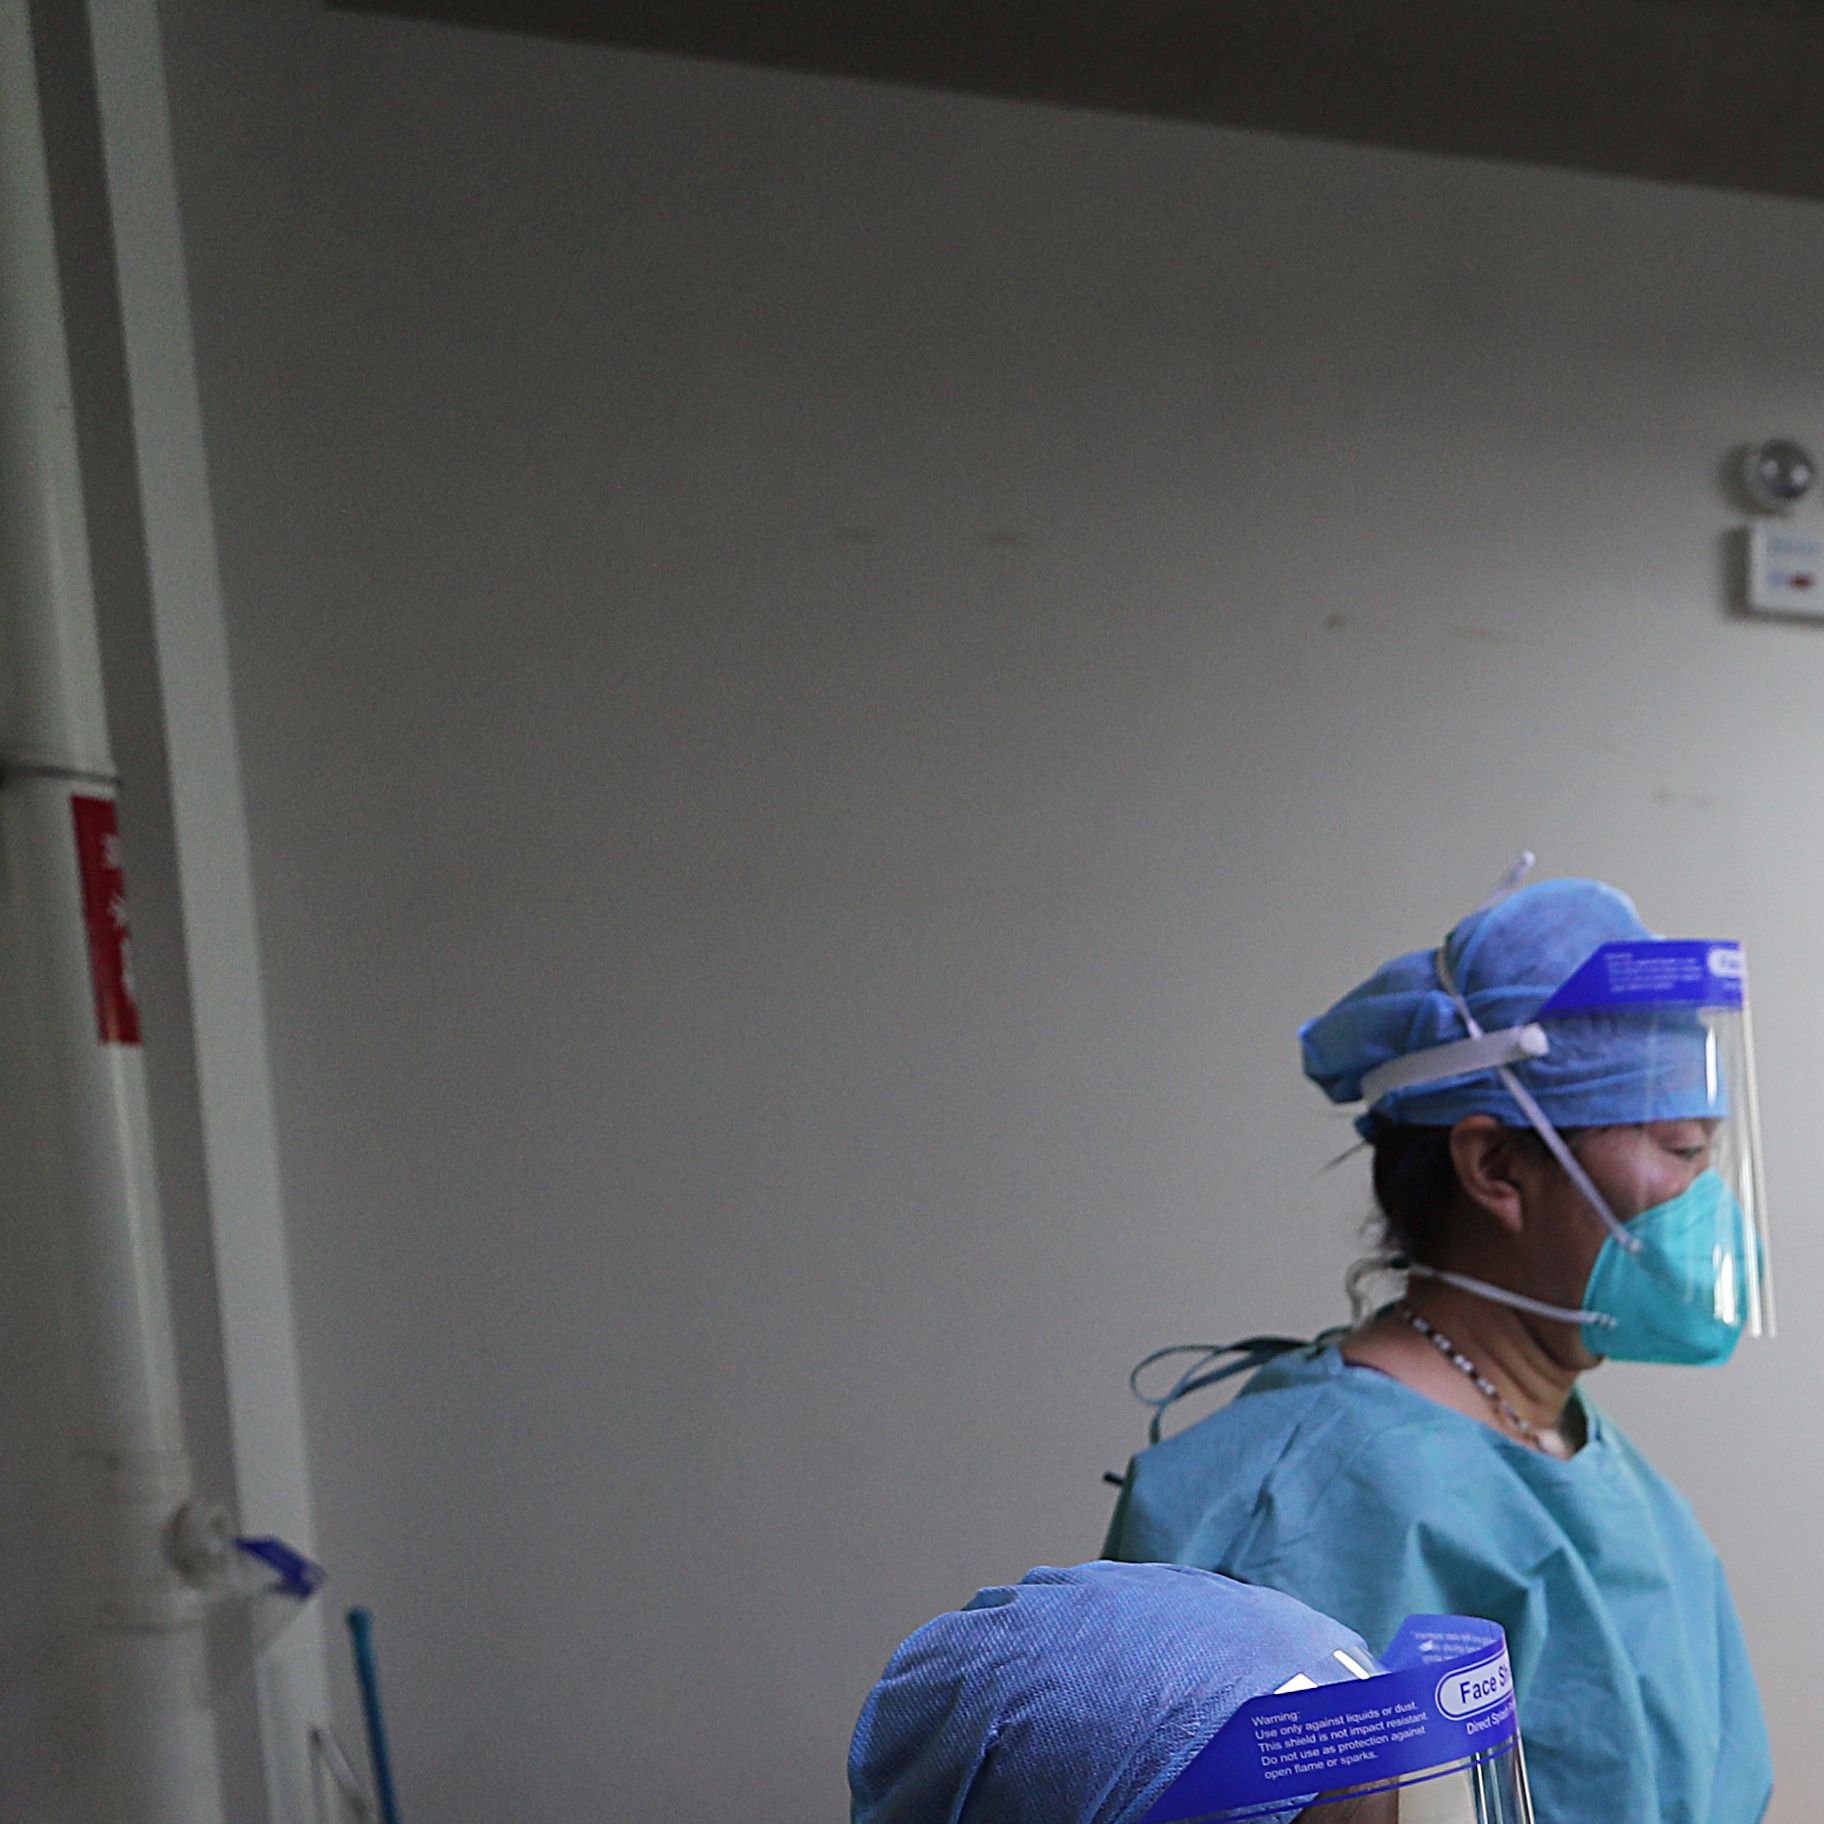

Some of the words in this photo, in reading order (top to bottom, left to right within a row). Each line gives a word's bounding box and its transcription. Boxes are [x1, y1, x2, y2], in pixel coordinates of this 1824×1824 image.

[1459, 1676, 1497, 1704] Face
[1252, 1711, 1300, 1727] Warning:
[1255, 1730, 1277, 1740] Use
[1280, 1723, 1302, 1737] only
[1305, 1715, 1344, 1732] against
[1346, 1708, 1380, 1723] liquids
[1381, 1706, 1392, 1716] or
[1258, 1742, 1282, 1753] This
[1285, 1735, 1316, 1749] shield
[1319, 1731, 1328, 1742] is
[1330, 1727, 1349, 1739] not
[1350, 1722, 1384, 1737] impact
[1261, 1756, 1278, 1767] Do
[1280, 1752, 1298, 1764] not
[1300, 1748, 1320, 1759] use
[1322, 1745, 1336, 1755] as
[1338, 1733, 1389, 1753] protection
[1391, 1725, 1426, 1742] against
[1264, 1768, 1292, 1780] open
[1294, 1761, 1325, 1774] flame
[1327, 1758, 1338, 1768] or
